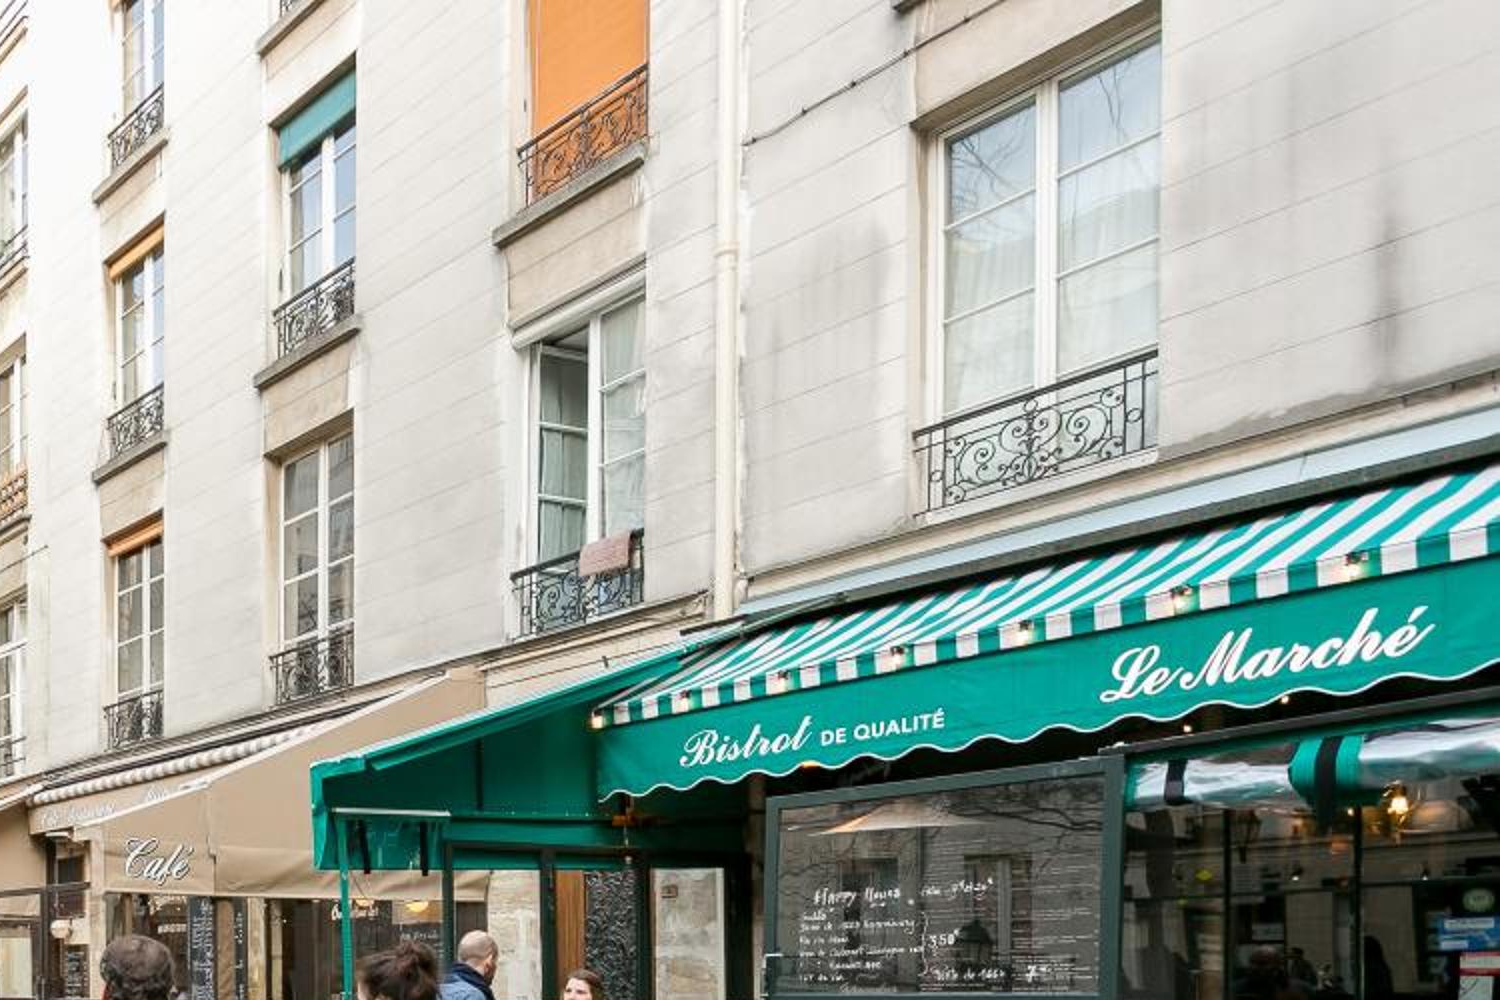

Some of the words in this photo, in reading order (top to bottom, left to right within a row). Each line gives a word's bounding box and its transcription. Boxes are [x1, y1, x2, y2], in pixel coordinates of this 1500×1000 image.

[1099, 644, 1183, 703] Le
[1178, 604, 1436, 691] Marché
[678, 714, 814, 768] Bistrot
[820, 726, 848, 747] DE
[853, 708, 946, 741] QUALITÉ
[124, 836, 195, 887] Café
